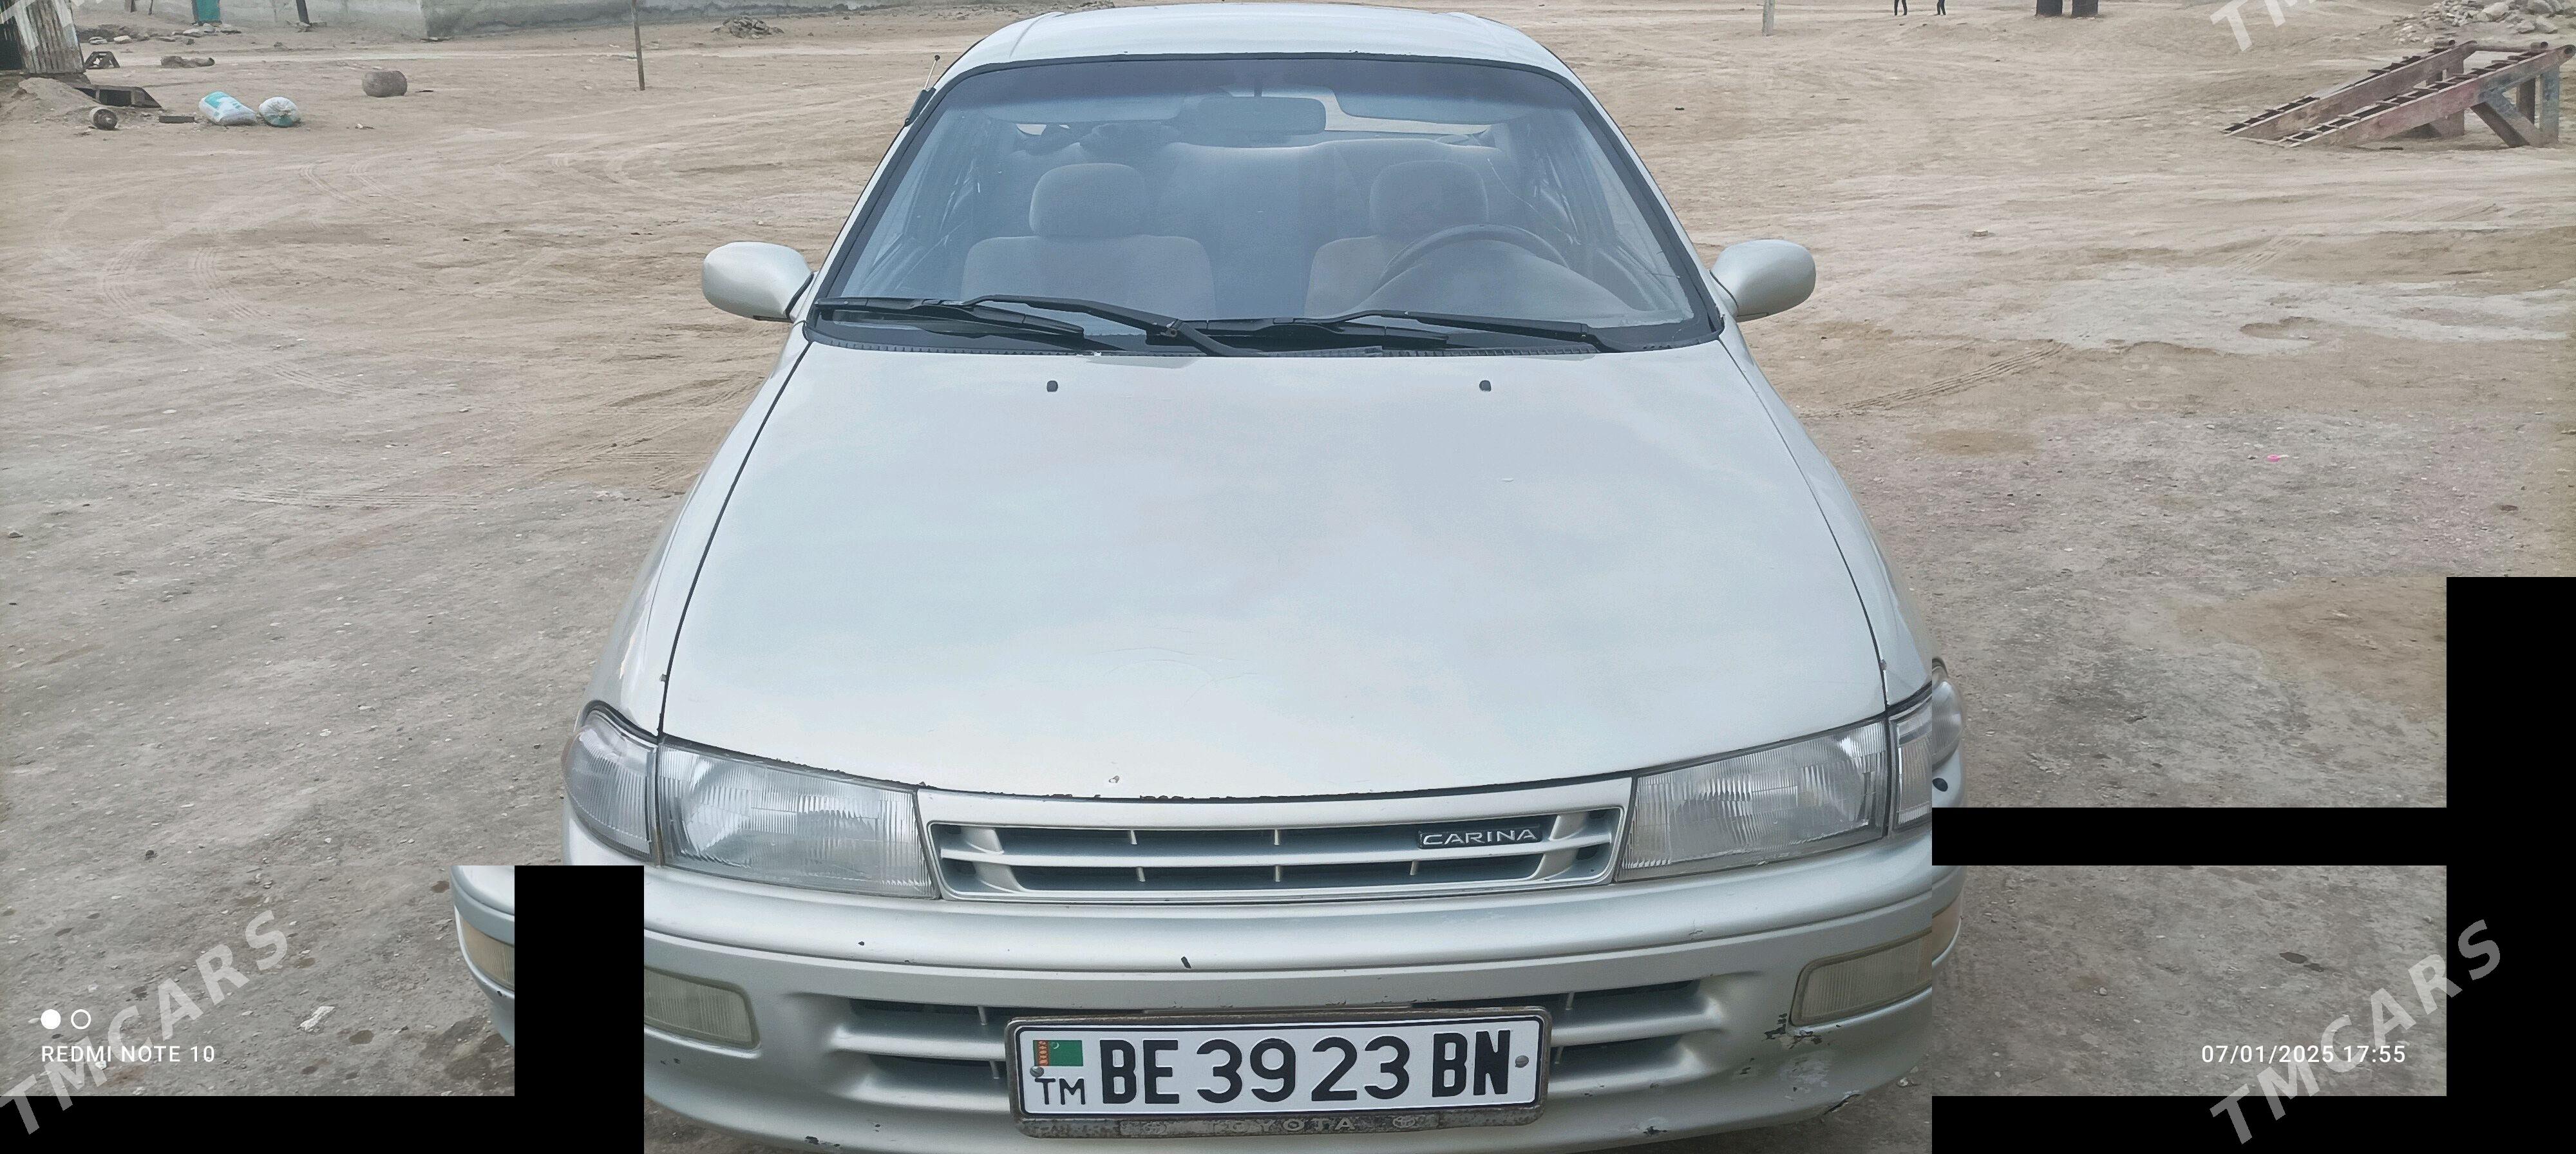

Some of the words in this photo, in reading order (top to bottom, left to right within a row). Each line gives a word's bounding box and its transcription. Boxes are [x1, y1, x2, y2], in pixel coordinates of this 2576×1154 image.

[1423, 829, 1538, 846] CARINA
[1099, 1039, 1180, 1105] BE
[1432, 1030, 1511, 1098] BN
[1034, 1078, 1086, 1105] TM
[1208, 1115, 1355, 1133] OYOTA
